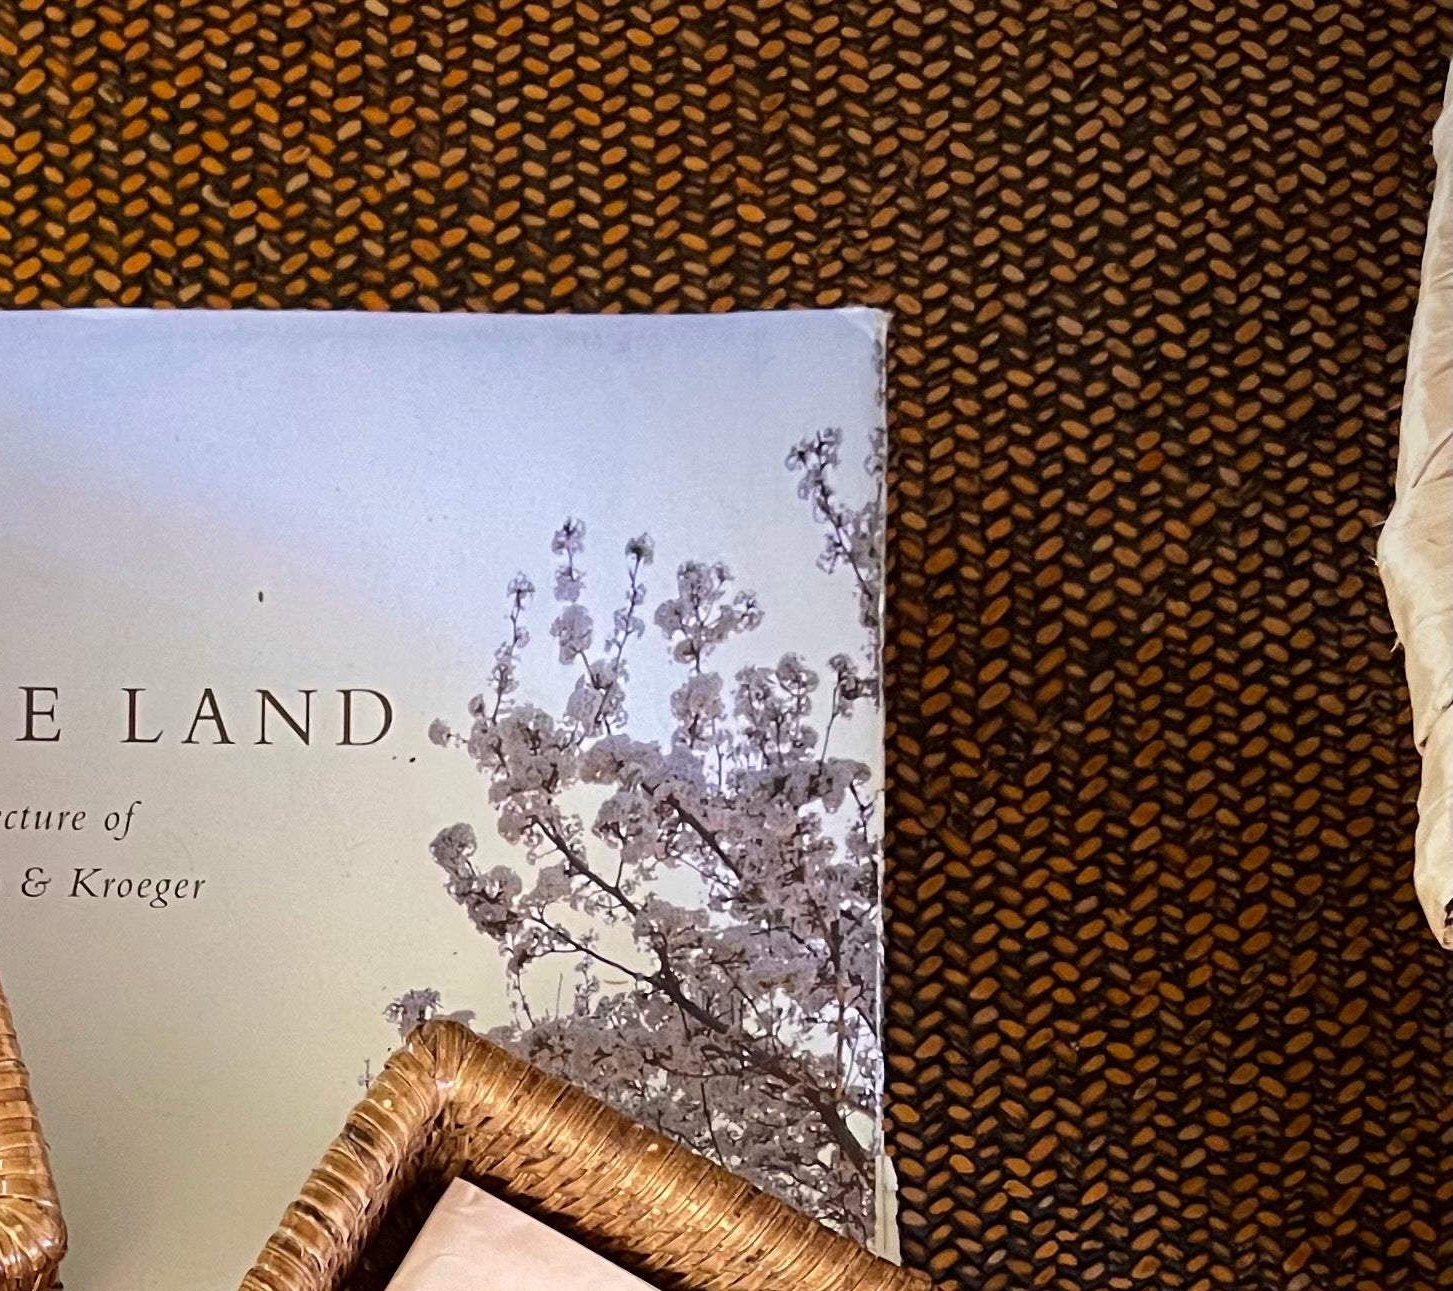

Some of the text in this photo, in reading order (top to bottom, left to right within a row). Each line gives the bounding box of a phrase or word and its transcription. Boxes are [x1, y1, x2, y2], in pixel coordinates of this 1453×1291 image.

[120, 687, 394, 747] LAND
[103, 800, 142, 841] of
[20, 867, 51, 898] &
[68, 868, 206, 909] Kroeger
